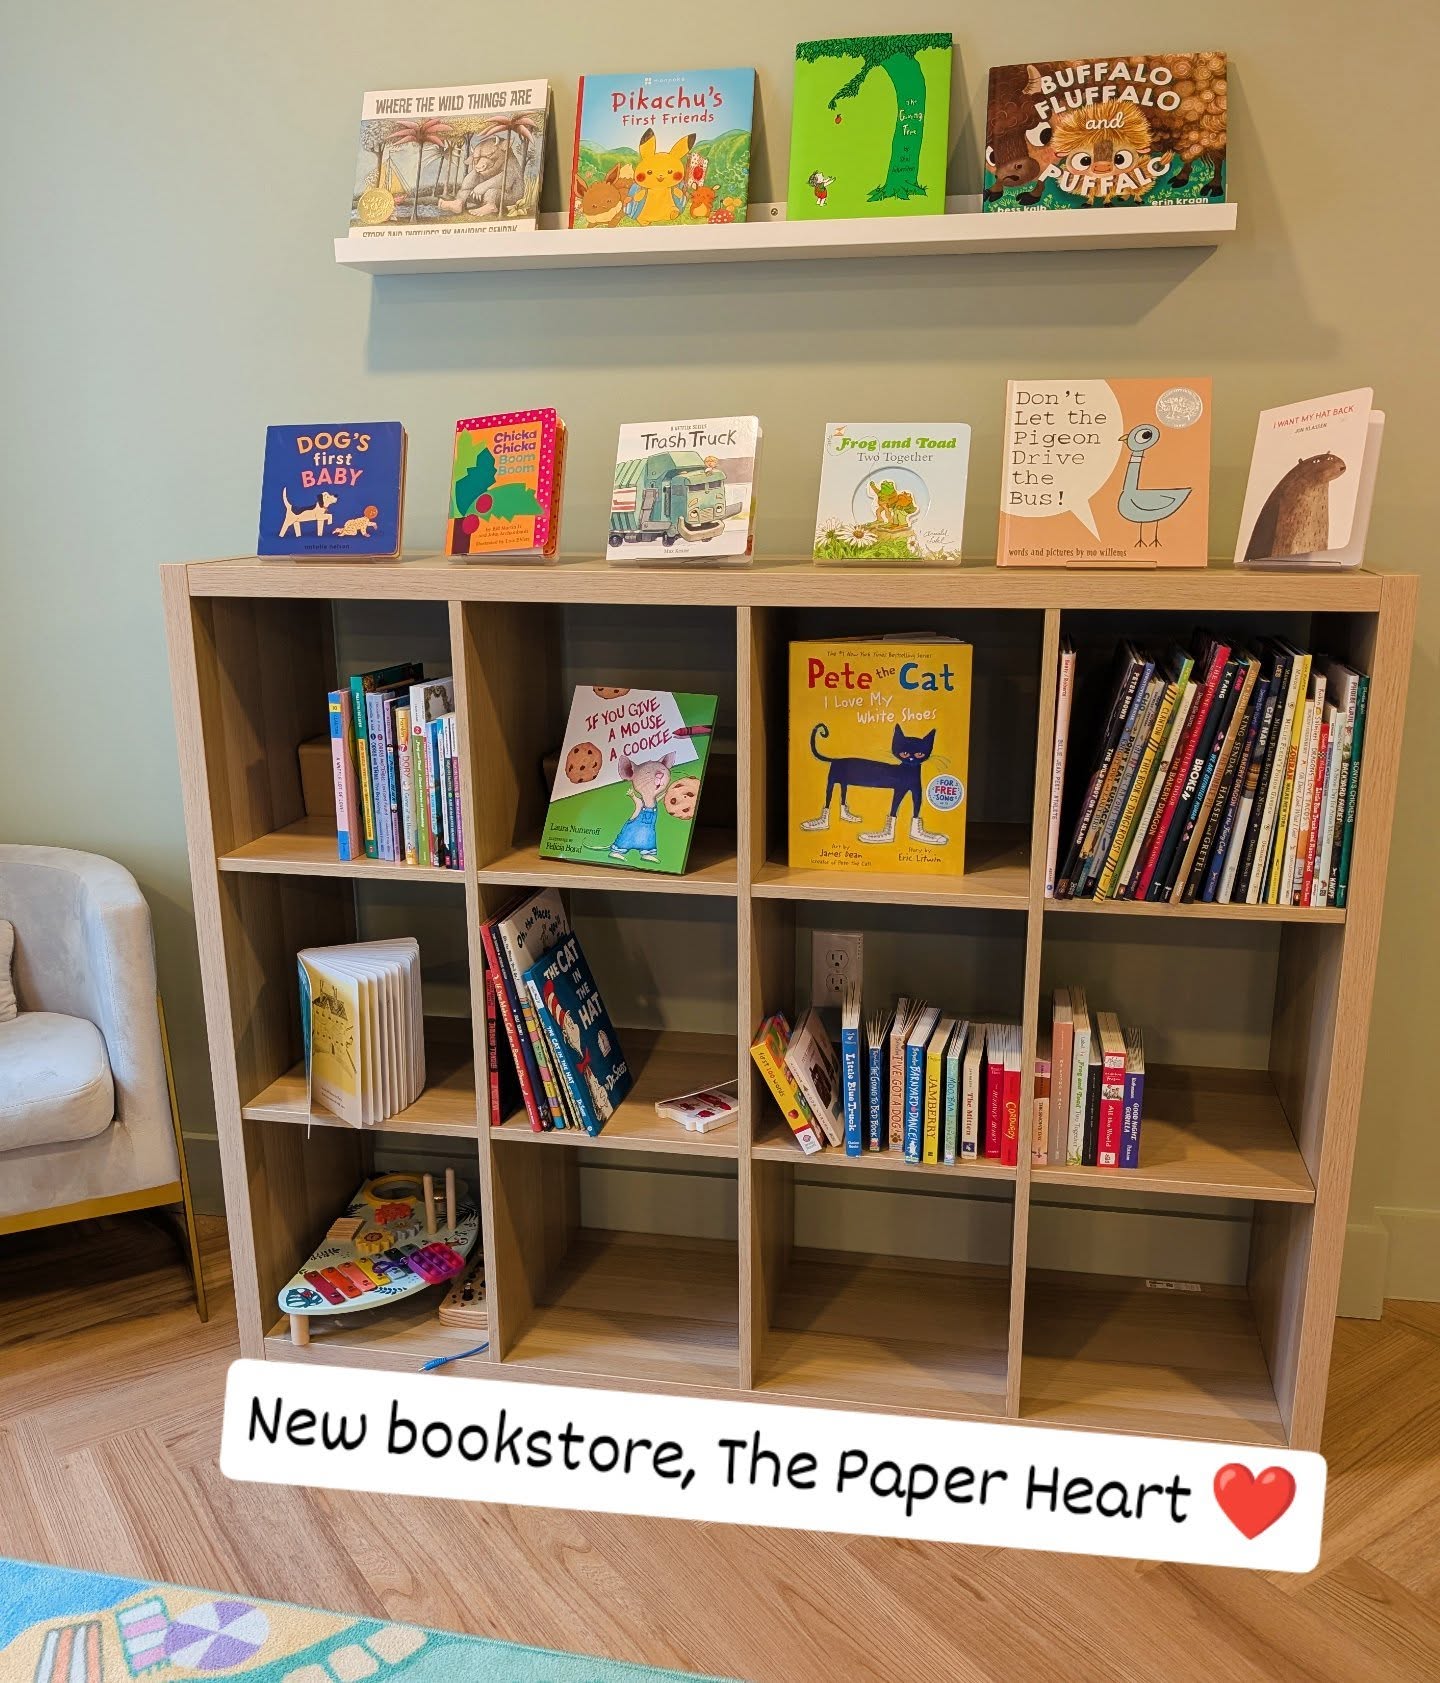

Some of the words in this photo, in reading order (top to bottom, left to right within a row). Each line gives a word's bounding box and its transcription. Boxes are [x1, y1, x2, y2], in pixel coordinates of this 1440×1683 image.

[1040, 62, 1172, 94] BUFFALO
[376, 98, 412, 114] WHERE
[416, 96, 436, 112] THE
[438, 94, 464, 112] WILD
[467, 92, 506, 110] THINGS
[510, 89, 532, 106] ARE
[610, 86, 723, 112] Pikachu's
[1034, 85, 1181, 120] FLUFFALO
[622, 114, 656, 126] First
[662, 110, 714, 124] Friends
[1086, 112, 1125, 130] and
[1040, 156, 1170, 196] PUFFALO
[1176, 197, 1209, 205] kraan
[1016, 390, 1086, 405] Don't
[1014, 411, 1055, 425] Let
[1068, 410, 1107, 425] the
[1278, 417, 1299, 428] WANT
[1302, 414, 1314, 422] MY
[1316, 410, 1331, 419] HAT
[1333, 405, 1354, 416] BACK
[296, 432, 371, 454] DOG'S
[494, 430, 537, 443] Chicka
[640, 432, 686, 450] Trash
[688, 430, 737, 448] Truck
[836, 438, 878, 452] Frog
[881, 438, 912, 448] and
[916, 438, 957, 448] Toad
[1014, 430, 1101, 448] Pigeon
[493, 441, 537, 454] Chicka
[1012, 450, 1085, 464] Drive
[314, 452, 352, 466] first
[500, 453, 536, 465] Boom
[857, 452, 880, 462] Two
[883, 452, 934, 464] Together
[302, 468, 364, 488] BABY
[498, 464, 536, 476] Boom
[1012, 470, 1054, 484] the
[1009, 491, 1064, 506] Bus!
[1030, 548, 1044, 556] and
[1046, 548, 1074, 558] pictures
[1076, 548, 1084, 558] by
[808, 658, 872, 690] Pete
[876, 666, 896, 678] the
[899, 662, 954, 691] Cat
[1127, 671, 1139, 693] PETER
[1224, 670, 1232, 678] X.
[1217, 679, 1229, 699] FANG
[824, 696, 828, 708] I
[834, 695, 864, 708] Love
[870, 692, 894, 707] My
[1118, 694, 1132, 720] BROWN
[1138, 692, 1150, 712] CHO
[584, 713, 599, 732] IF
[602, 705, 625, 724] YOU
[628, 697, 660, 716] GIVE
[857, 711, 894, 724] White
[901, 708, 936, 722] Shoes
[1263, 706, 1273, 724] CAT
[608, 728, 616, 742] A
[620, 714, 666, 740] MOUSE
[1236, 714, 1249, 737] KING
[1258, 726, 1268, 745] NAP
[610, 748, 618, 762] A
[623, 729, 672, 756] COOKIE
[1103, 747, 1113, 761] THE
[1120, 735, 1135, 762] DON'T
[1139, 757, 1151, 775] THIS
[1170, 756, 1181, 771] THE
[1205, 762, 1214, 773] ARE
[1208, 753, 1217, 763] WE
[1224, 741, 1241, 776] SENDAK
[1308, 747, 1317, 775] DRAGONS
[1097, 762, 1107, 778] WILD
[1112, 764, 1125, 784] EAT
[1180, 756, 1204, 801] BROKEN
[1338, 762, 1348, 796] BACKYARD
[1350, 761, 1359, 789] SONYA'S
[935, 786, 957, 796] FREE
[1090, 778, 1102, 799] ROBOT
[1132, 774, 1145, 794] BOOK
[1159, 771, 1175, 802] BAKERY
[936, 794, 954, 802] SONG
[1087, 799, 1095, 808] ON
[1129, 794, 1138, 803] IS
[1313, 787, 1322, 801] Little
[1083, 807, 1092, 821] THE
[1098, 785, 1117, 825] EUSTACE
[1303, 798, 1311, 820] TACOS
[1312, 802, 1320, 813] Blue
[1335, 798, 1344, 821] FAIRIES
[1346, 790, 1356, 823] CHICKENS
[550, 823, 568, 832] Laura
[1111, 803, 1135, 853] DANGEROUS!
[1147, 802, 1165, 836] DRAGON
[1310, 814, 1319, 829] Truck
[1075, 822, 1087, 844] ISLAND
[1309, 830, 1317, 842] and
[820, 850, 842, 858] James
[898, 854, 912, 862] Eric
[916, 854, 942, 862] Litwin
[1307, 842, 1315, 860] Racer
[544, 962, 560, 980] THE
[556, 938, 579, 972] CAT
[572, 968, 582, 984] IN
[576, 982, 590, 1000] THE
[578, 992, 602, 1030] HAT
[545, 1025, 554, 1036] THE
[550, 1037, 560, 1050] CAT
[556, 1050, 563, 1058] IN
[560, 1060, 568, 1070] THE
[565, 1071, 574, 1084] HAT
[757, 1051, 769, 1067] first
[765, 1067, 775, 1079] 100
[771, 1078, 785, 1097] words
[845, 1053, 855, 1079] Little
[847, 1081, 856, 1100] Blue
[926, 1074, 937, 1138] JAMBERRY
[1131, 1102, 1139, 1120] GOOD
[847, 1101, 857, 1131] Truck
[1123, 1106, 1131, 1133] GORILLA
